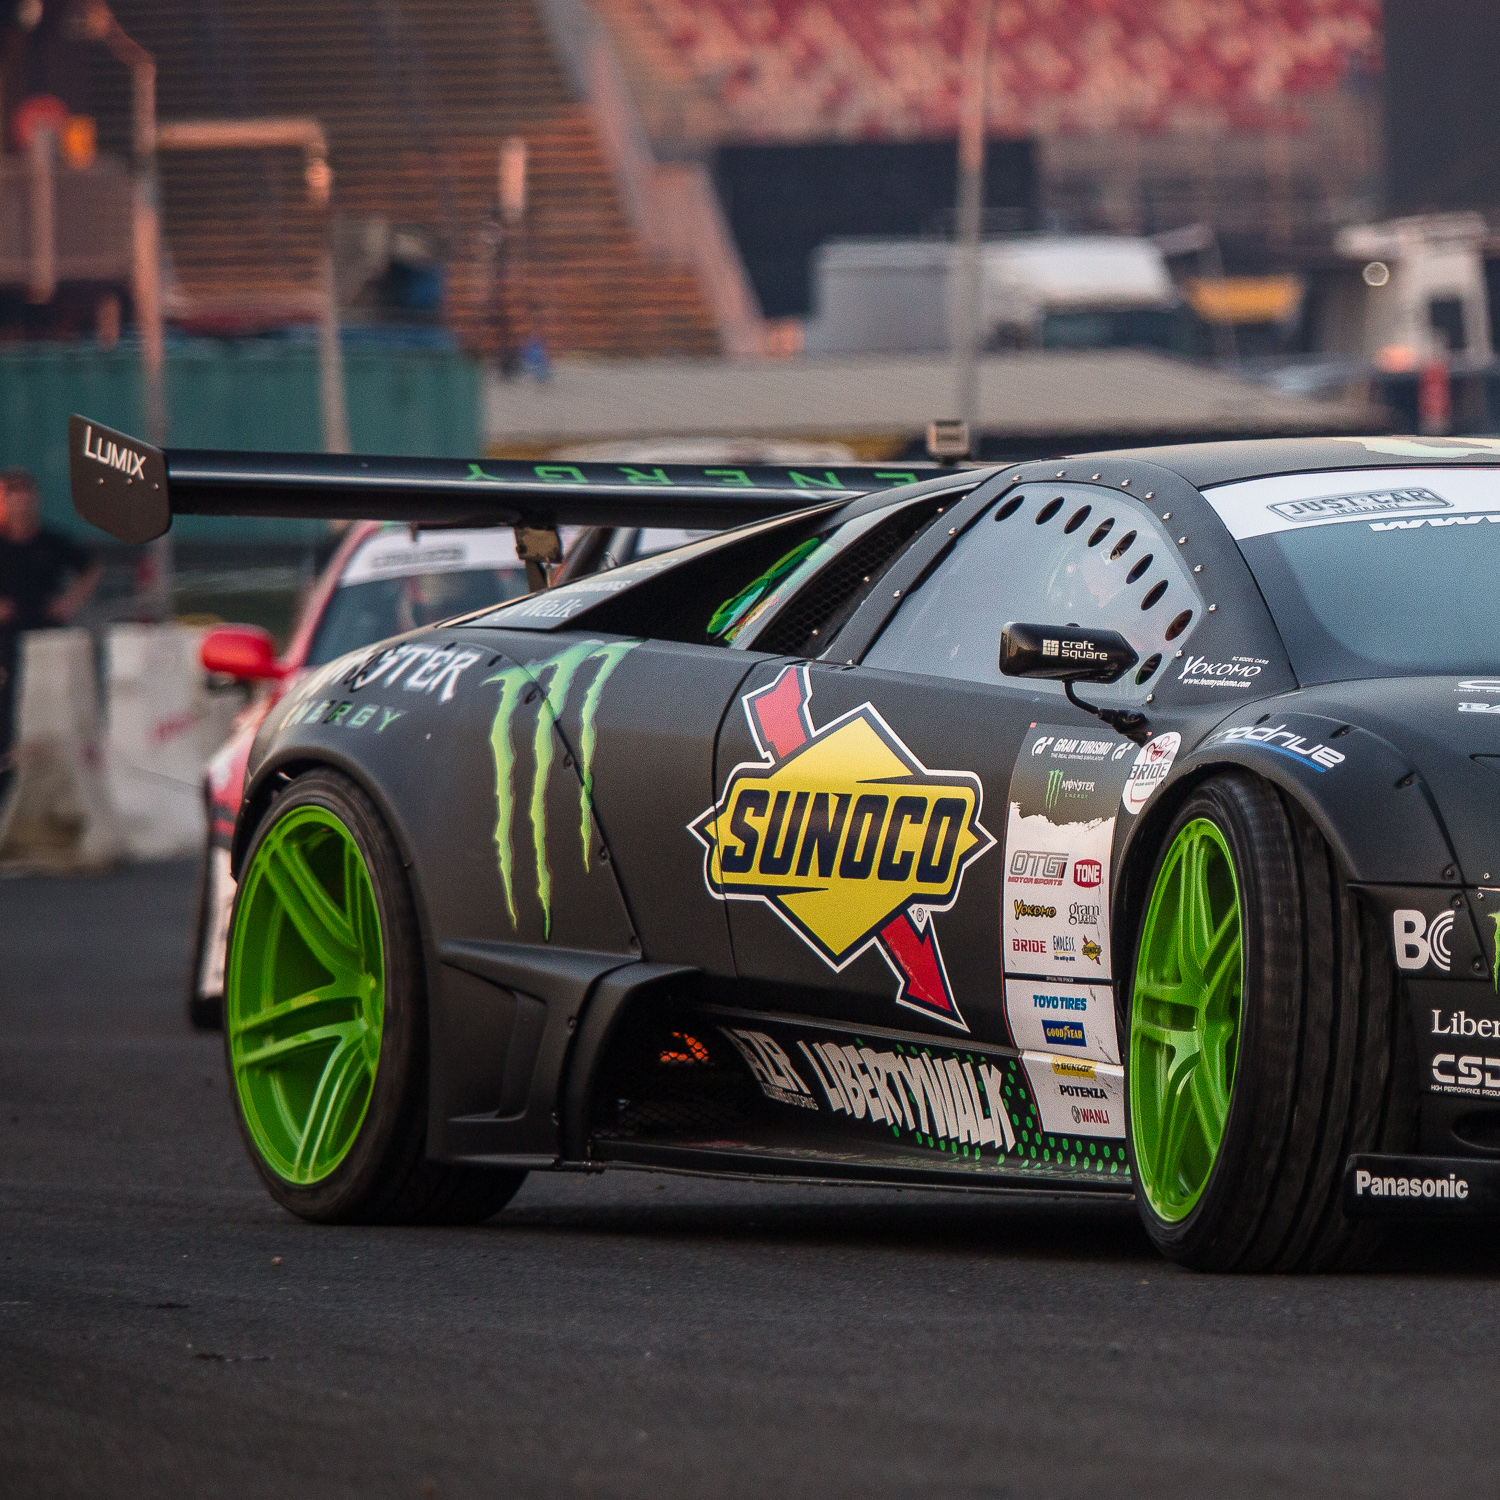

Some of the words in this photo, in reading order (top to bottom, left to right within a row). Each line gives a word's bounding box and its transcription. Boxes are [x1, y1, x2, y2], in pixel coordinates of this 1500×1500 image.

[85, 425, 147, 480] LUMIX
[1289, 495, 1357, 514] JUST
[1367, 490, 1426, 505] CAR
[1062, 640, 1095, 650] craft
[1062, 650, 1108, 660] square
[1177, 655, 1262, 679] YOKOMO
[1053, 738, 1079, 753] GRAN
[1076, 740, 1114, 755] TURISMO
[1129, 762, 1171, 779] BRIDE
[720, 788, 967, 884] SUNOCO
[1010, 850, 1069, 879] OTG
[1075, 864, 1100, 883] TONE
[1014, 899, 1057, 920] YOKOMO
[1068, 902, 1100, 925] gram
[1012, 938, 1047, 953] BRIDE
[1052, 935, 1075, 951] ENDLESS
[1033, 994, 1059, 1010] TOYO
[1059, 996, 1088, 1011] TIRES
[1046, 1025, 1083, 1041] GOODYEAR
[797, 1040, 1016, 1152] LIBERTYWALK
[1059, 1084, 1109, 1100] POTENZA
[1443, 1086, 1480, 1095] PERFORMANCE
[1080, 1108, 1110, 1124] WANLI
[1356, 1169, 1469, 1200] Panasonic
